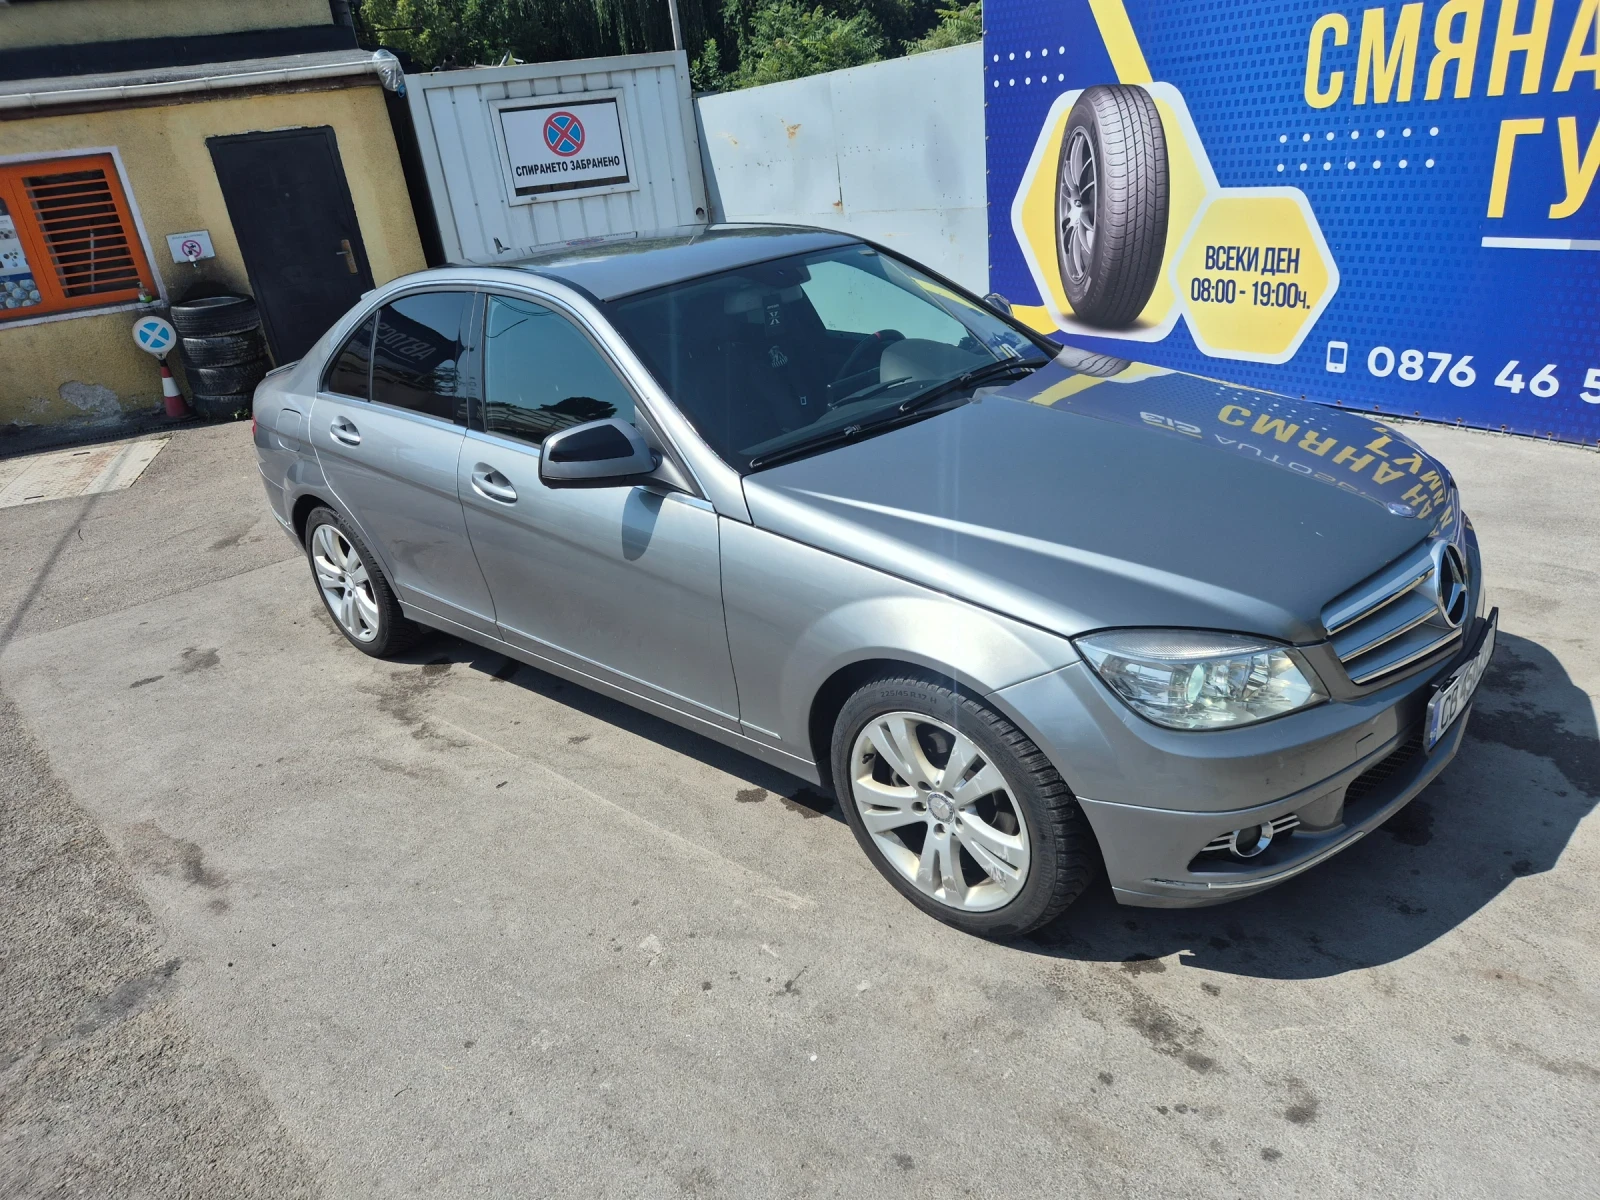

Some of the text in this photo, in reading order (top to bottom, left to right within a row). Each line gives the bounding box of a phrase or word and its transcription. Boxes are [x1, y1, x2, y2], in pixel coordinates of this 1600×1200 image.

[1304, 0, 1600, 109] СМЯНА
[516, 155, 620, 177] СПИРАНЕТО ЗАБРАНЕНО
[1205, 245, 1300, 276] ВСЕКИ ДЕН
[1191, 277, 1236, 304] 08:00
[1367, 346, 1477, 388] 0876
[1494, 360, 1560, 398] 46
[880, 690, 909, 698] 225/45
